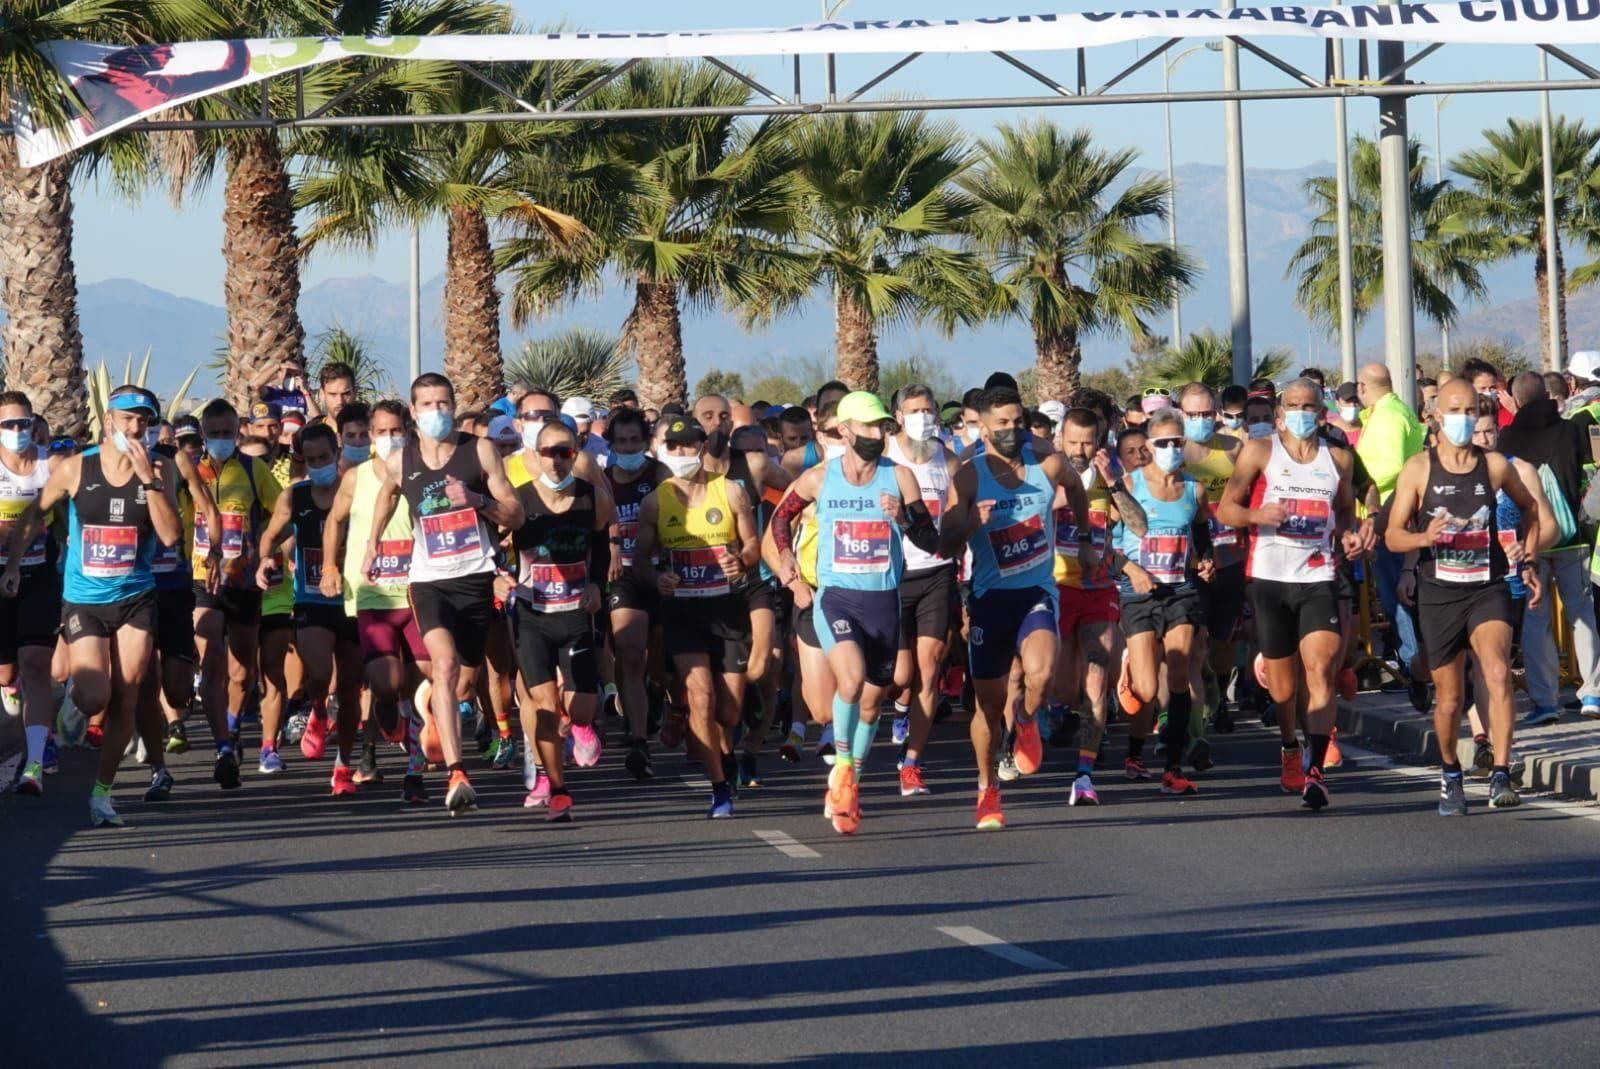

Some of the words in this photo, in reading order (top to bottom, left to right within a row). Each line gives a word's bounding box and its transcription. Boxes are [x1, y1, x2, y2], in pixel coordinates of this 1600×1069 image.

[828, 496, 875, 511] nerja
[1290, 515, 1307, 529] 64
[437, 531, 456, 547] 15
[842, 539, 870, 553] 166
[90, 543, 117, 558] 132
[1002, 538, 1029, 558] 246
[376, 556, 399, 568] 169
[1148, 553, 1173, 565] 177
[1441, 550, 1475, 562] 1322
[681, 565, 707, 579] 167
[545, 581, 564, 595] 45
